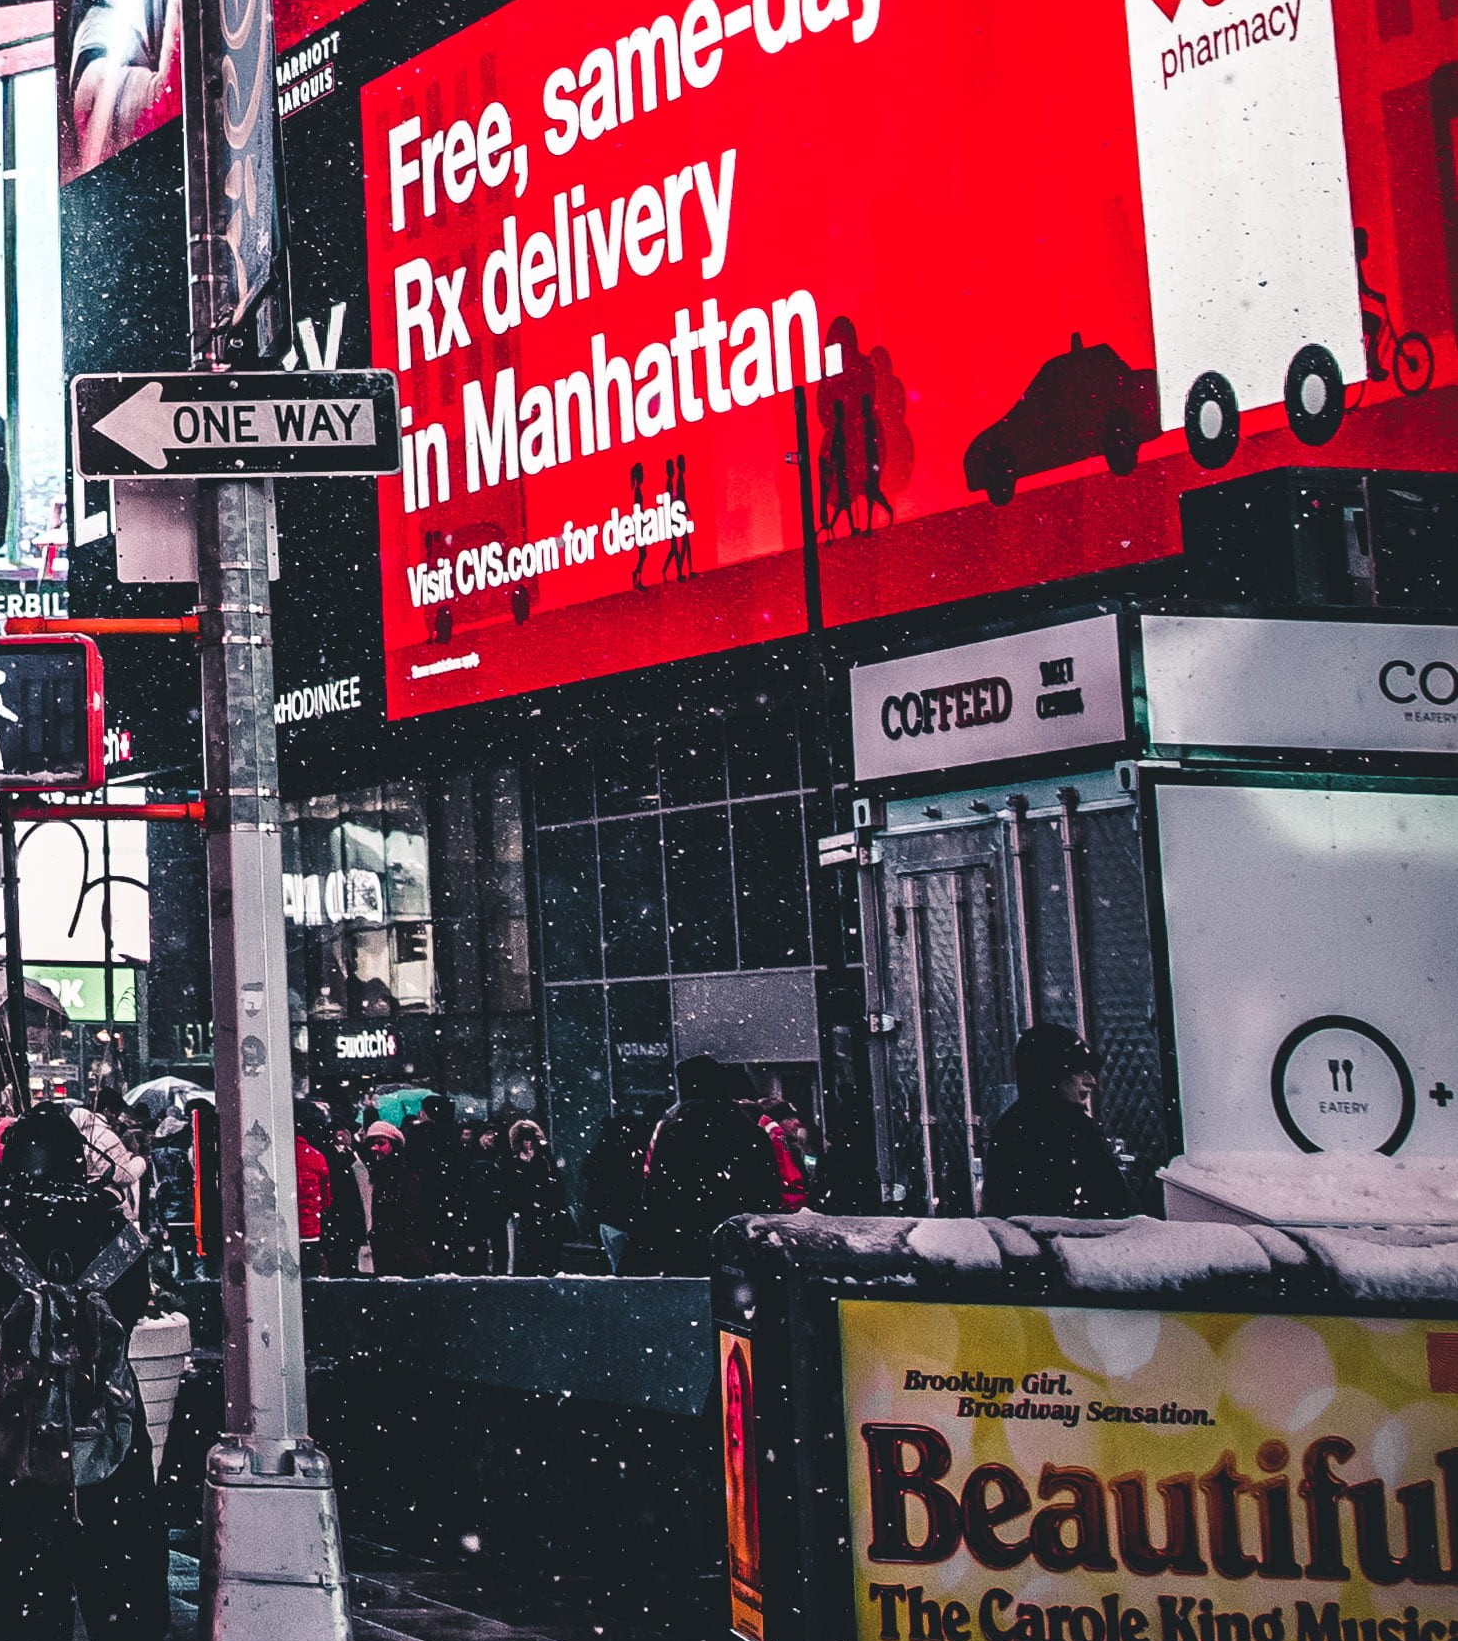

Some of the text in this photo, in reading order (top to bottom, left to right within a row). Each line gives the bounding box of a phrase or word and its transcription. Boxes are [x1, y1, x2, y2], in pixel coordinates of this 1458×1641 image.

[388, 101, 531, 232] Free,
[391, 233, 480, 371] Rx
[482, 147, 738, 338] delivery
[173, 404, 361, 444] ONE WAY
[401, 406, 450, 513] in
[465, 286, 843, 494] Manhattan.
[407, 496, 695, 607] Visit CVS.com for details.
[881, 676, 1013, 740] COFFEED
[337, 1029, 388, 1059] swatch
[1318, 1100, 1370, 1115] EATERY
[903, 1369, 1073, 1400] Brooklyn Girl.
[956, 1396, 1216, 1428] Broadway Sensation.
